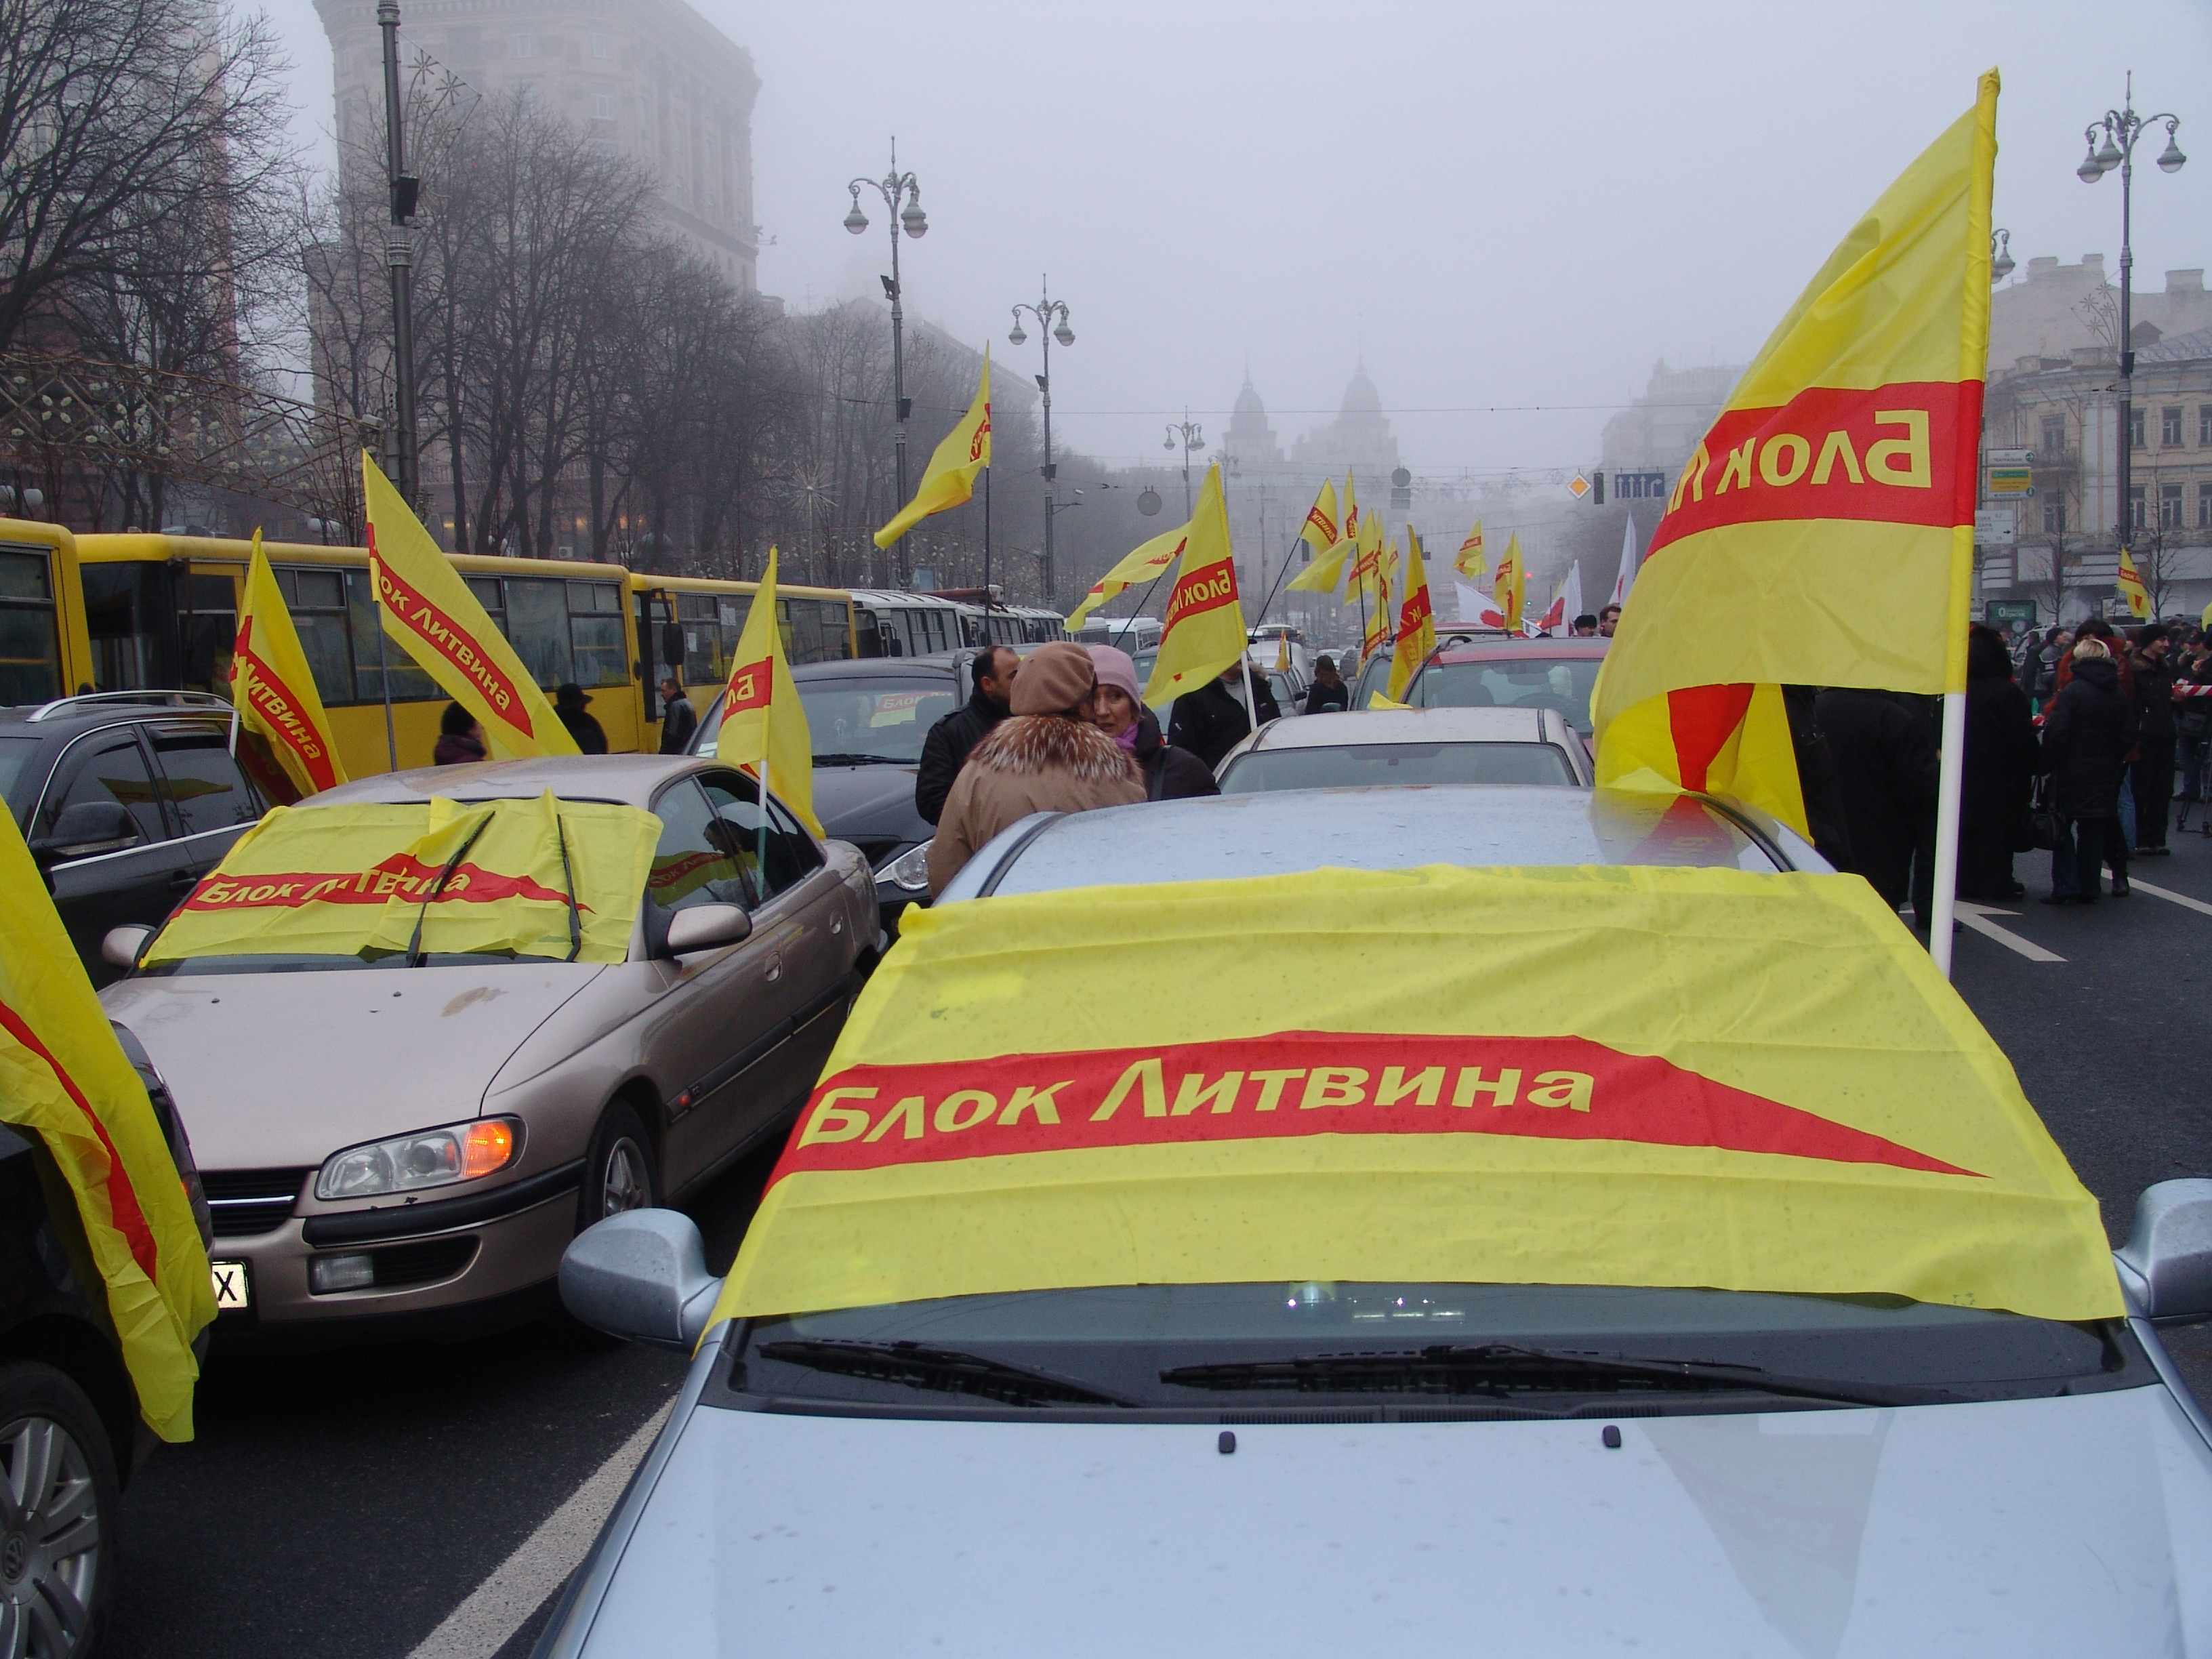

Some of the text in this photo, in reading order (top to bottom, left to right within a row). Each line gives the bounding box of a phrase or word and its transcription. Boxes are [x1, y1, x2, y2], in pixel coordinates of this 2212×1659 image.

[380, 575, 511, 712] ок Литвина
[196, 881, 305, 904] Блок
[796, 1057, 1596, 1151] Блок Литвина
